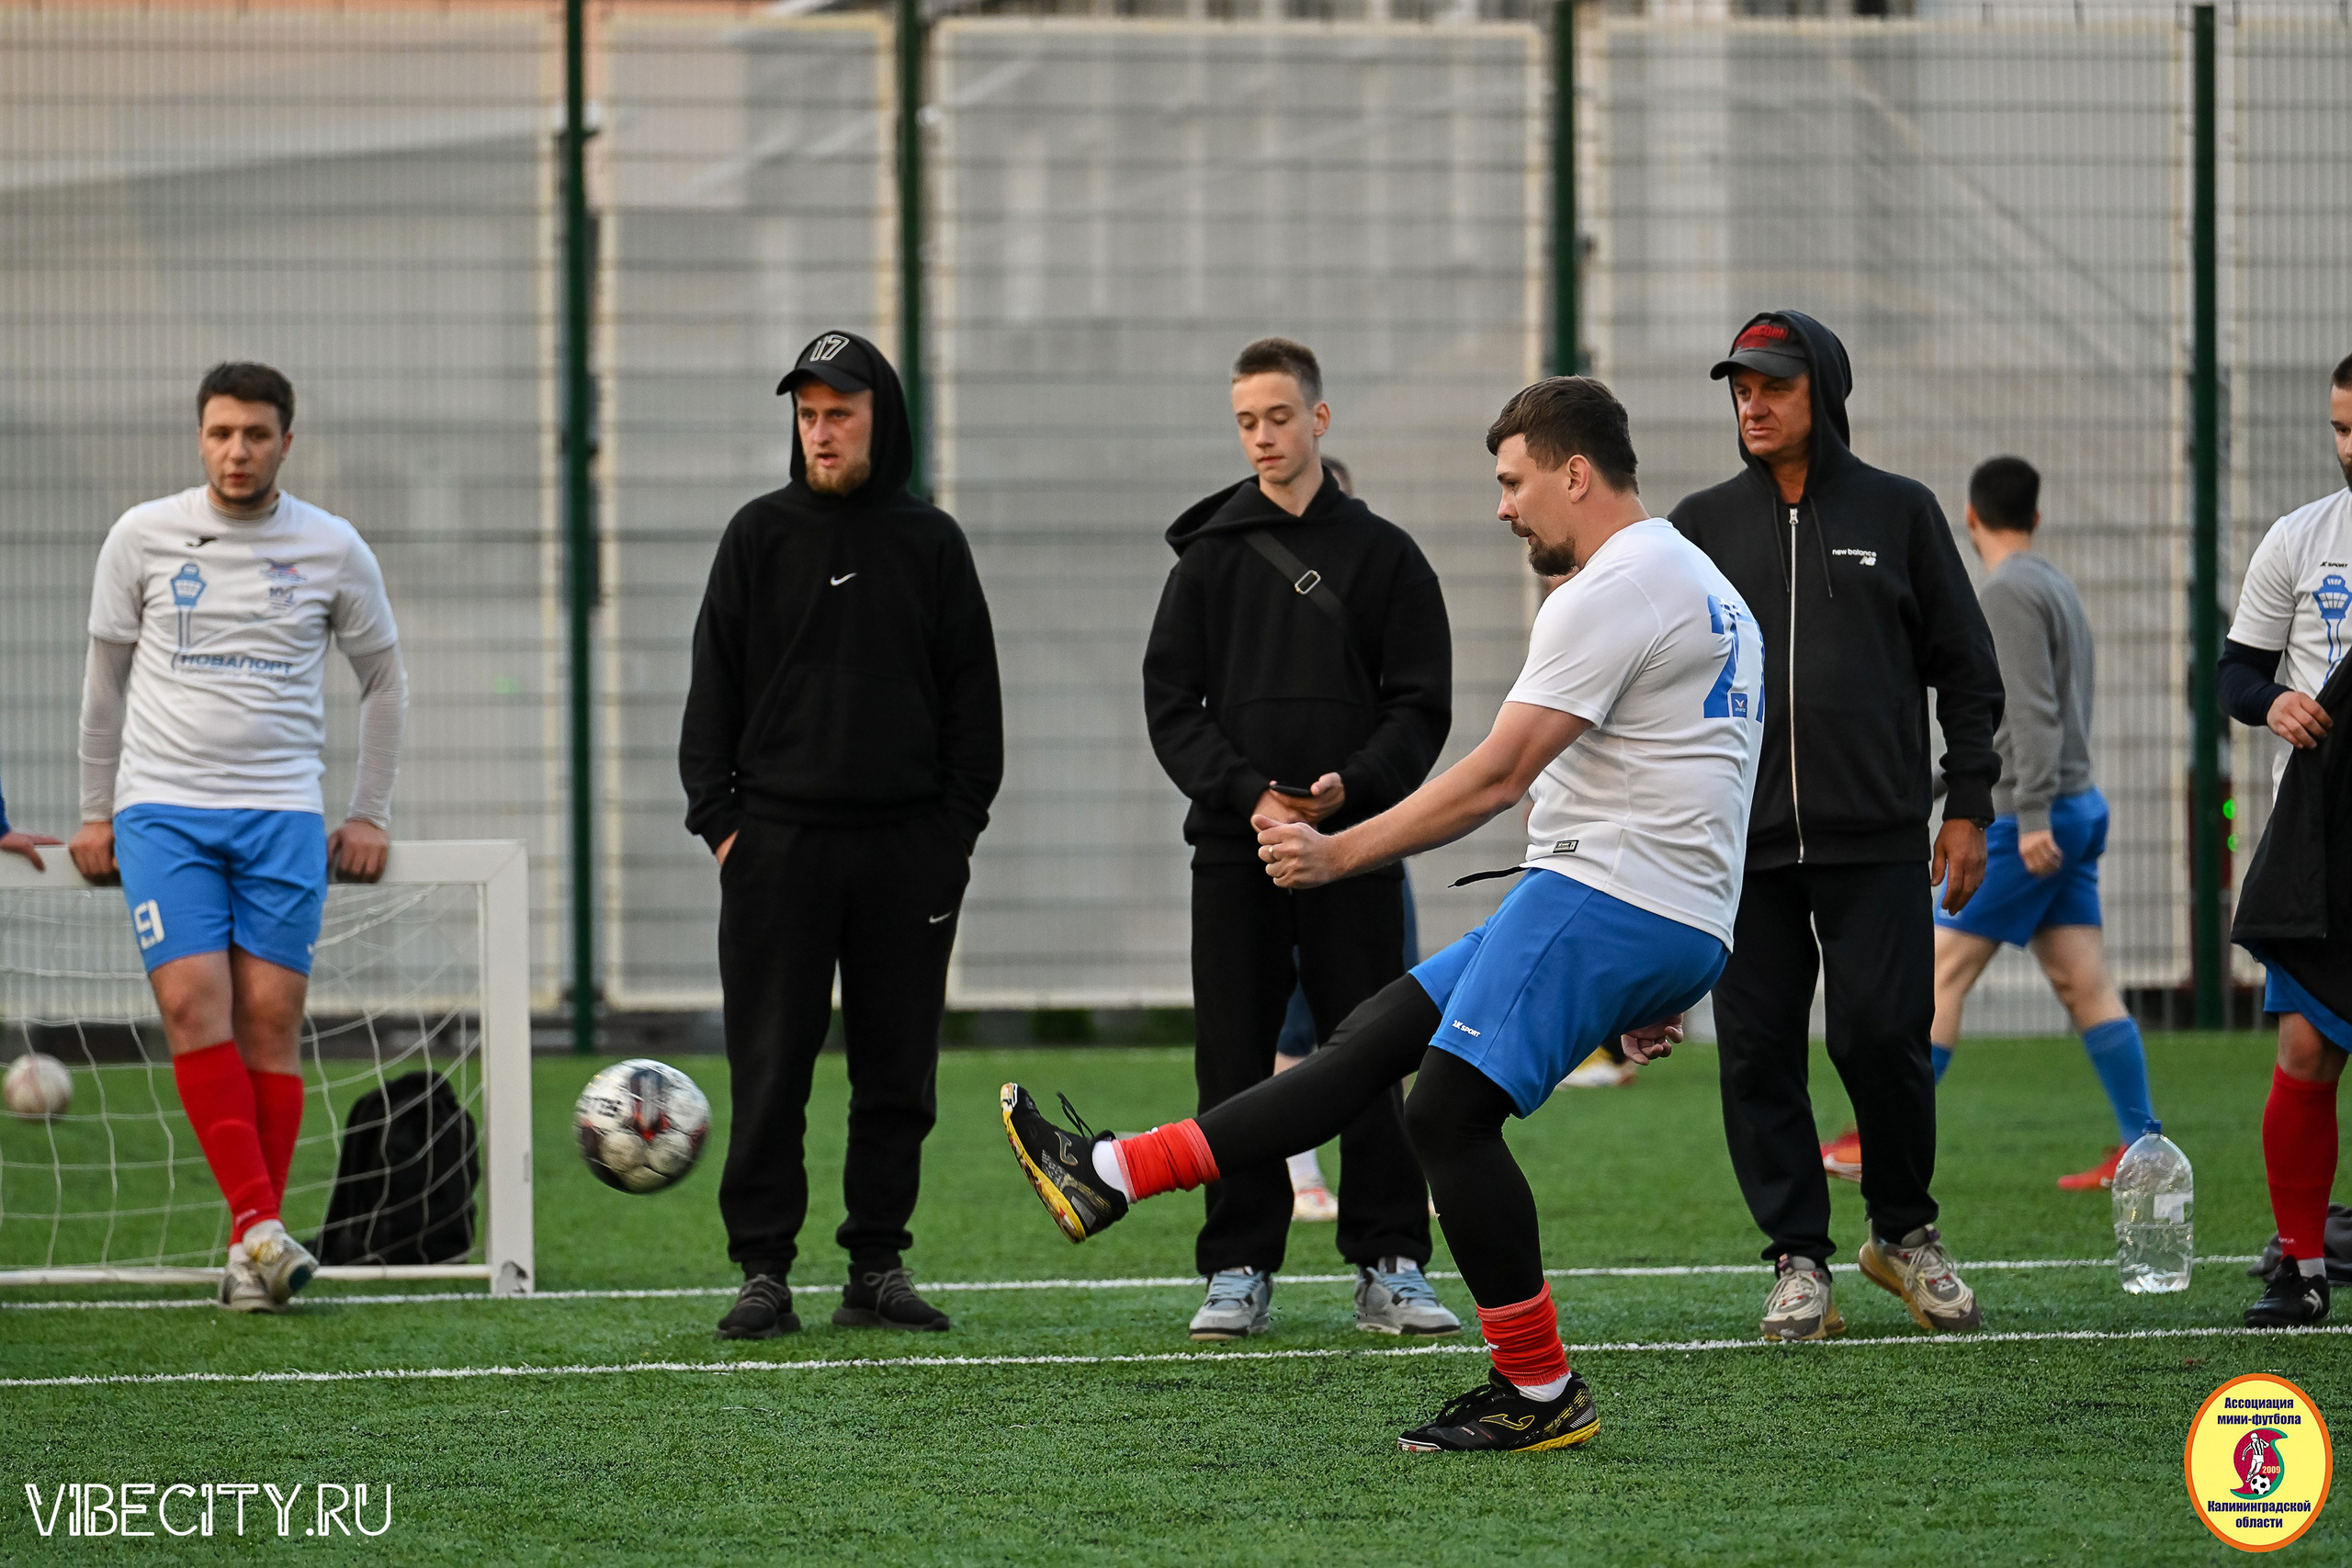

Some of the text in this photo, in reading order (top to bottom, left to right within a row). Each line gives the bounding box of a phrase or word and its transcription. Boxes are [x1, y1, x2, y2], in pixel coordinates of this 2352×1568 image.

[809, 334, 850, 362] 17
[1847, 548, 1877, 558] balance
[134, 899, 164, 950] 9
[1461, 1025, 1481, 1038] SPORT
